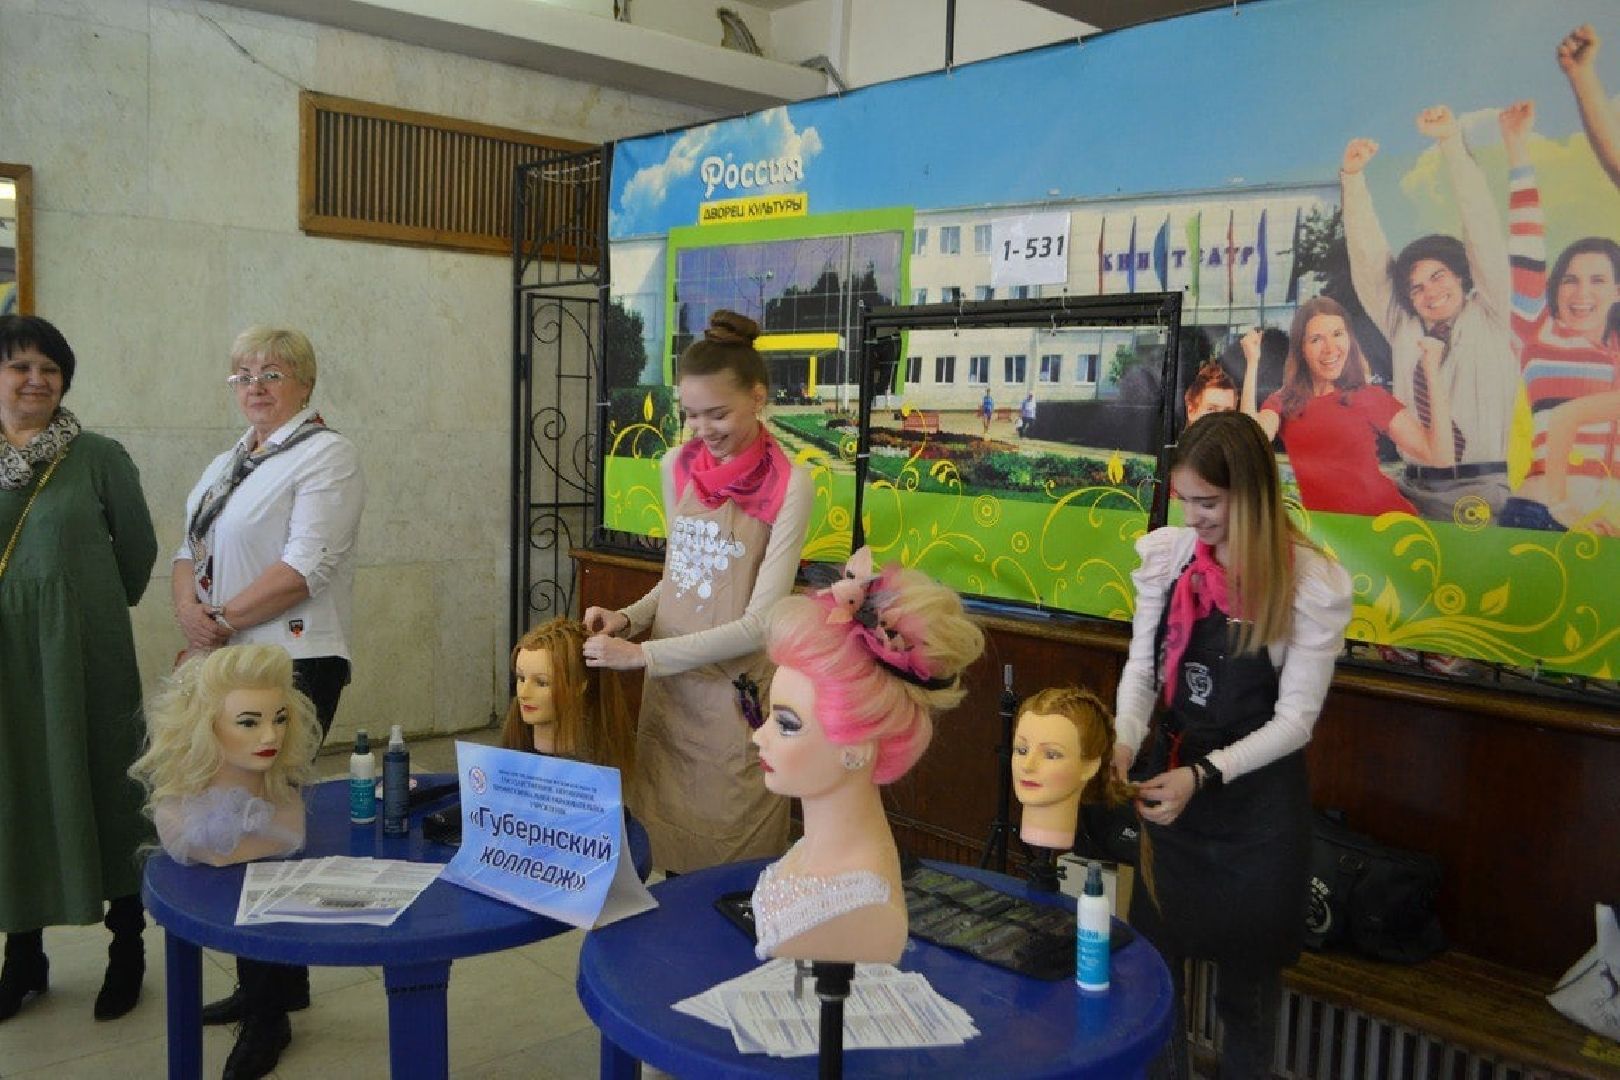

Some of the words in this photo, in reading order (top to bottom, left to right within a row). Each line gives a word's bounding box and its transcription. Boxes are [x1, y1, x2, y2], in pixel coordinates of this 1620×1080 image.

[701, 152, 804, 199] Россия
[703, 206, 744, 220] ДВОРЕЦ
[748, 198, 802, 216] КУЛЬТУРЫ
[1003, 235, 1064, 261] 1-531
[470, 806, 612, 862] «Губернский
[480, 846, 586, 892] колледж»
